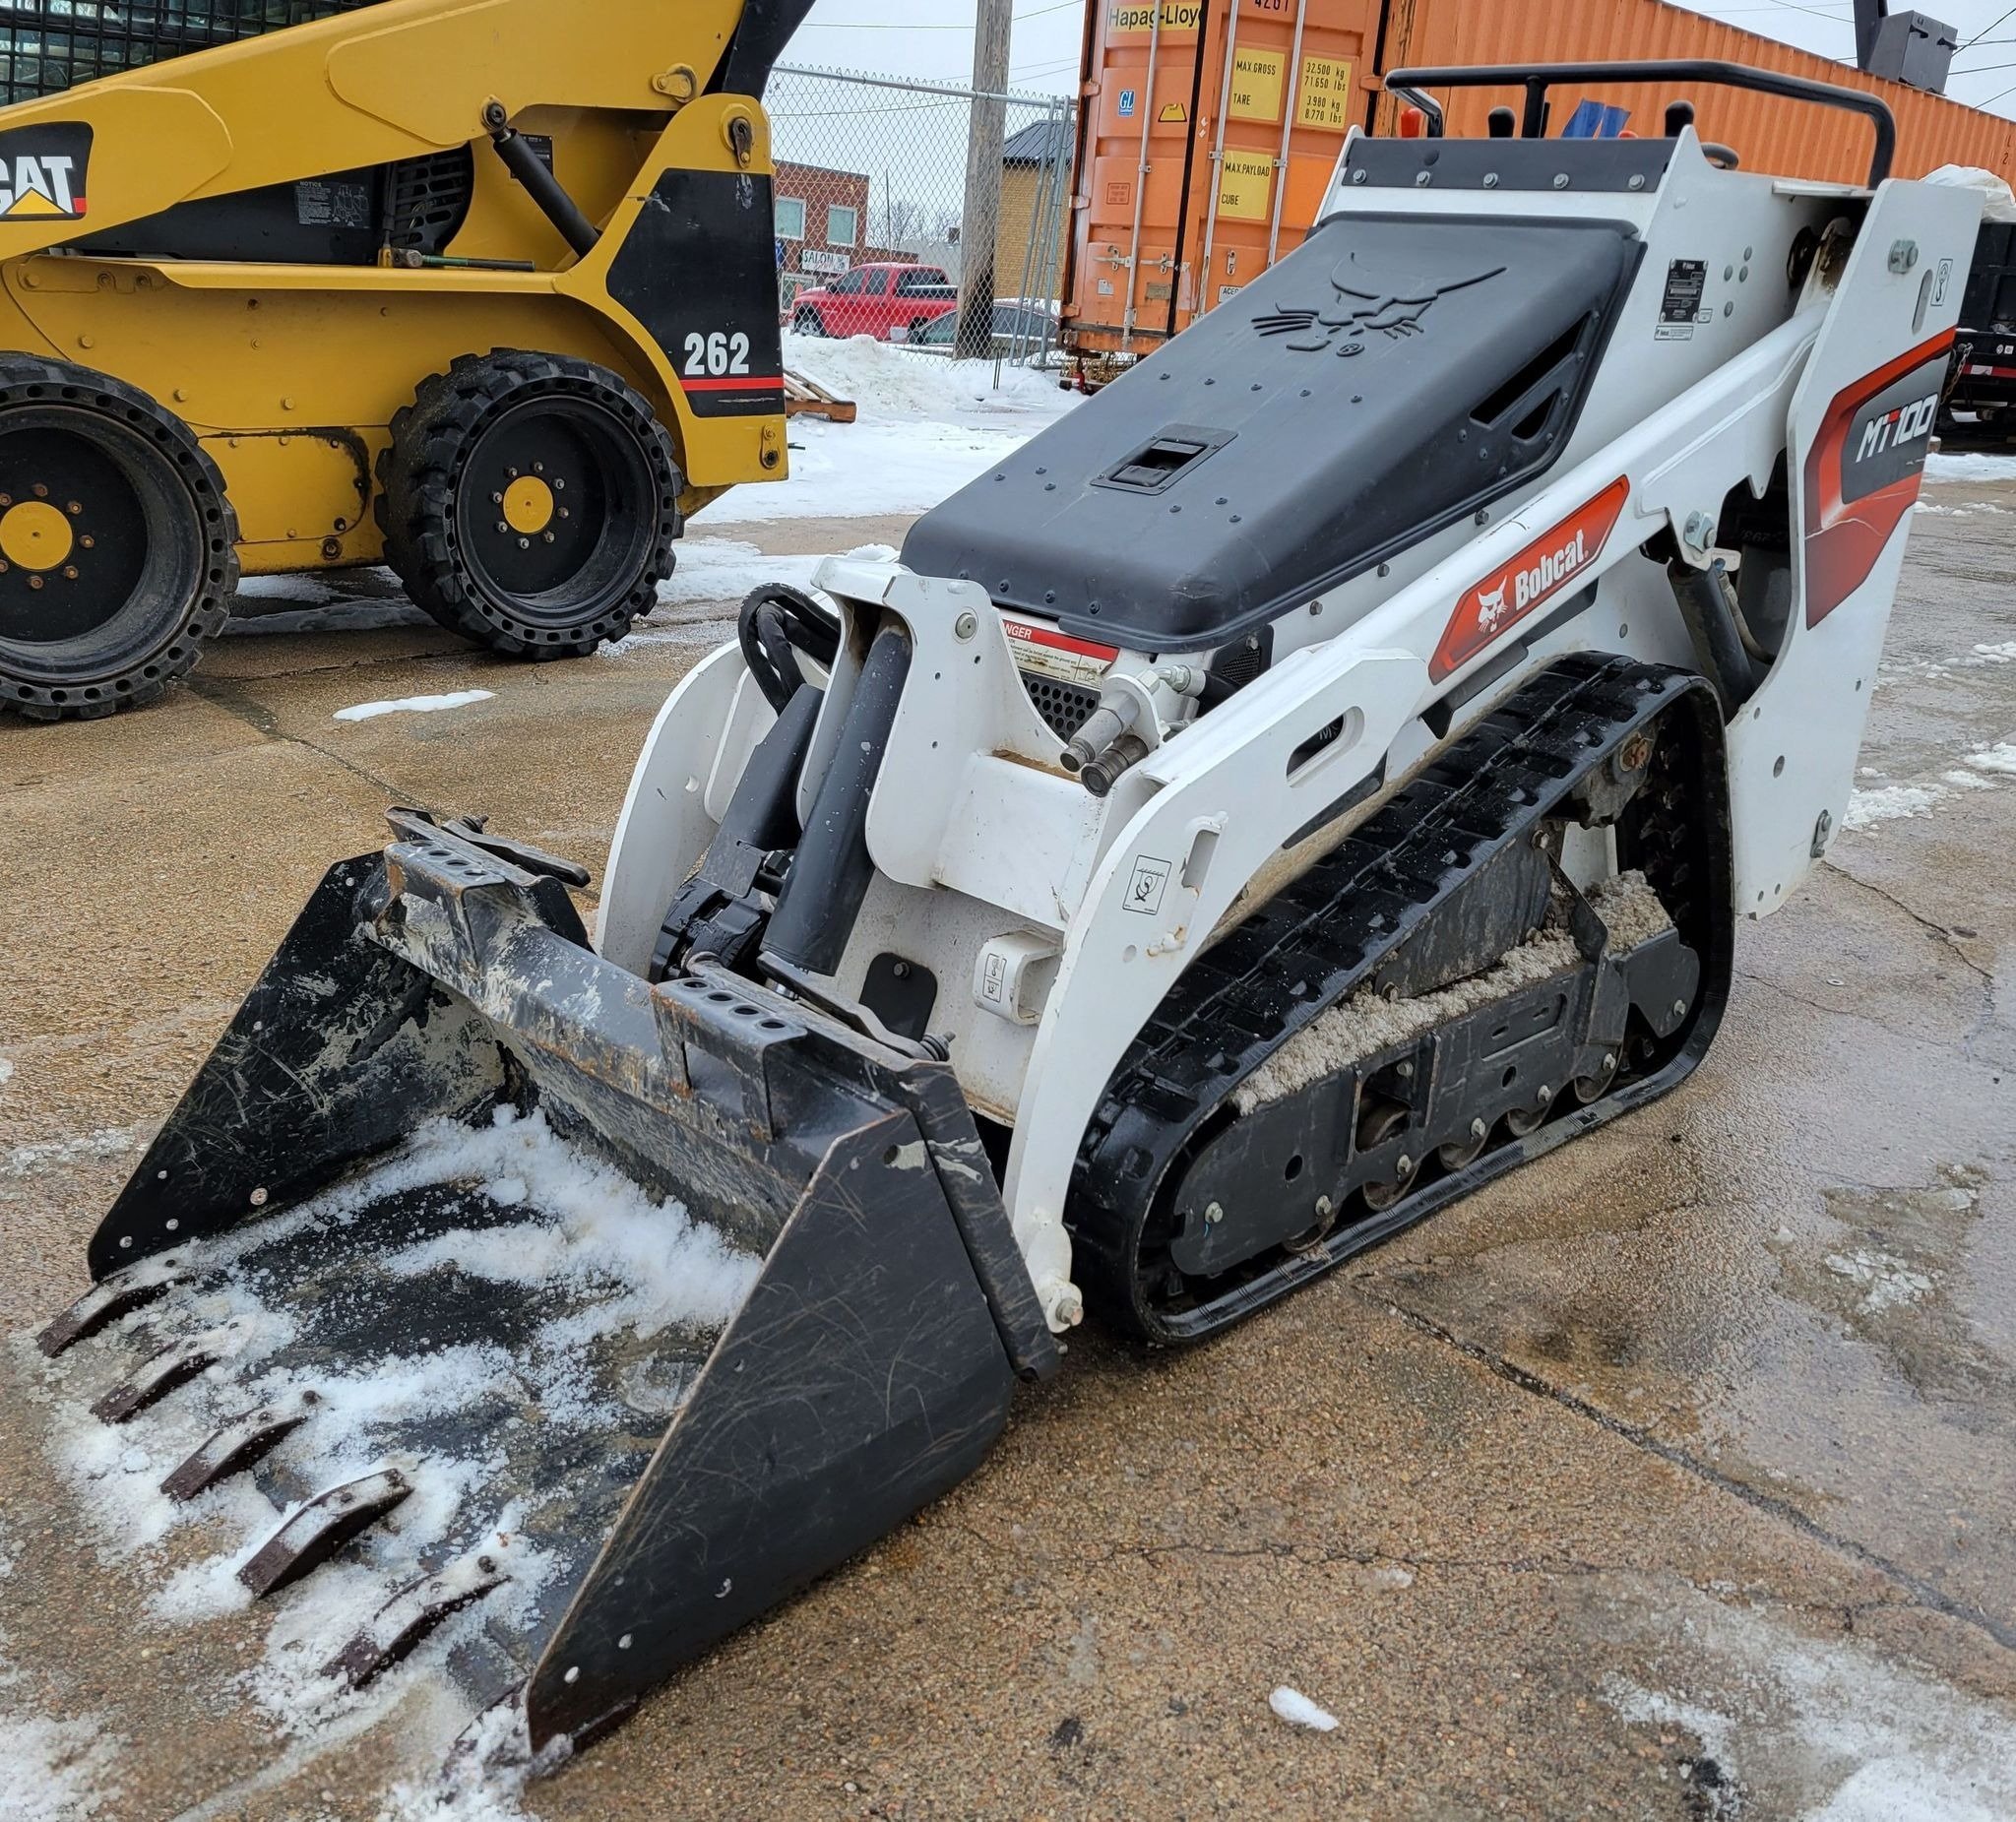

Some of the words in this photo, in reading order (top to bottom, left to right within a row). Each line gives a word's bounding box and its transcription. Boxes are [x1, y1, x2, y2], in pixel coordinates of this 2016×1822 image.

[1109, 5, 1201, 30] Hapag-Lloy
[1336, 66, 1345, 80] kg
[1334, 81, 1346, 92] lbs
[1120, 91, 1134, 108] GL
[1233, 94, 1251, 105] TARE
[1332, 98, 1340, 112] kg
[1330, 114, 1342, 124] lbs
[1222, 193, 1239, 205] CUBE
[804, 250, 835, 266] SALON
[684, 332, 749, 375] 262
[1515, 529, 1584, 611] Bobcat
[1005, 624, 1032, 639] NGER
